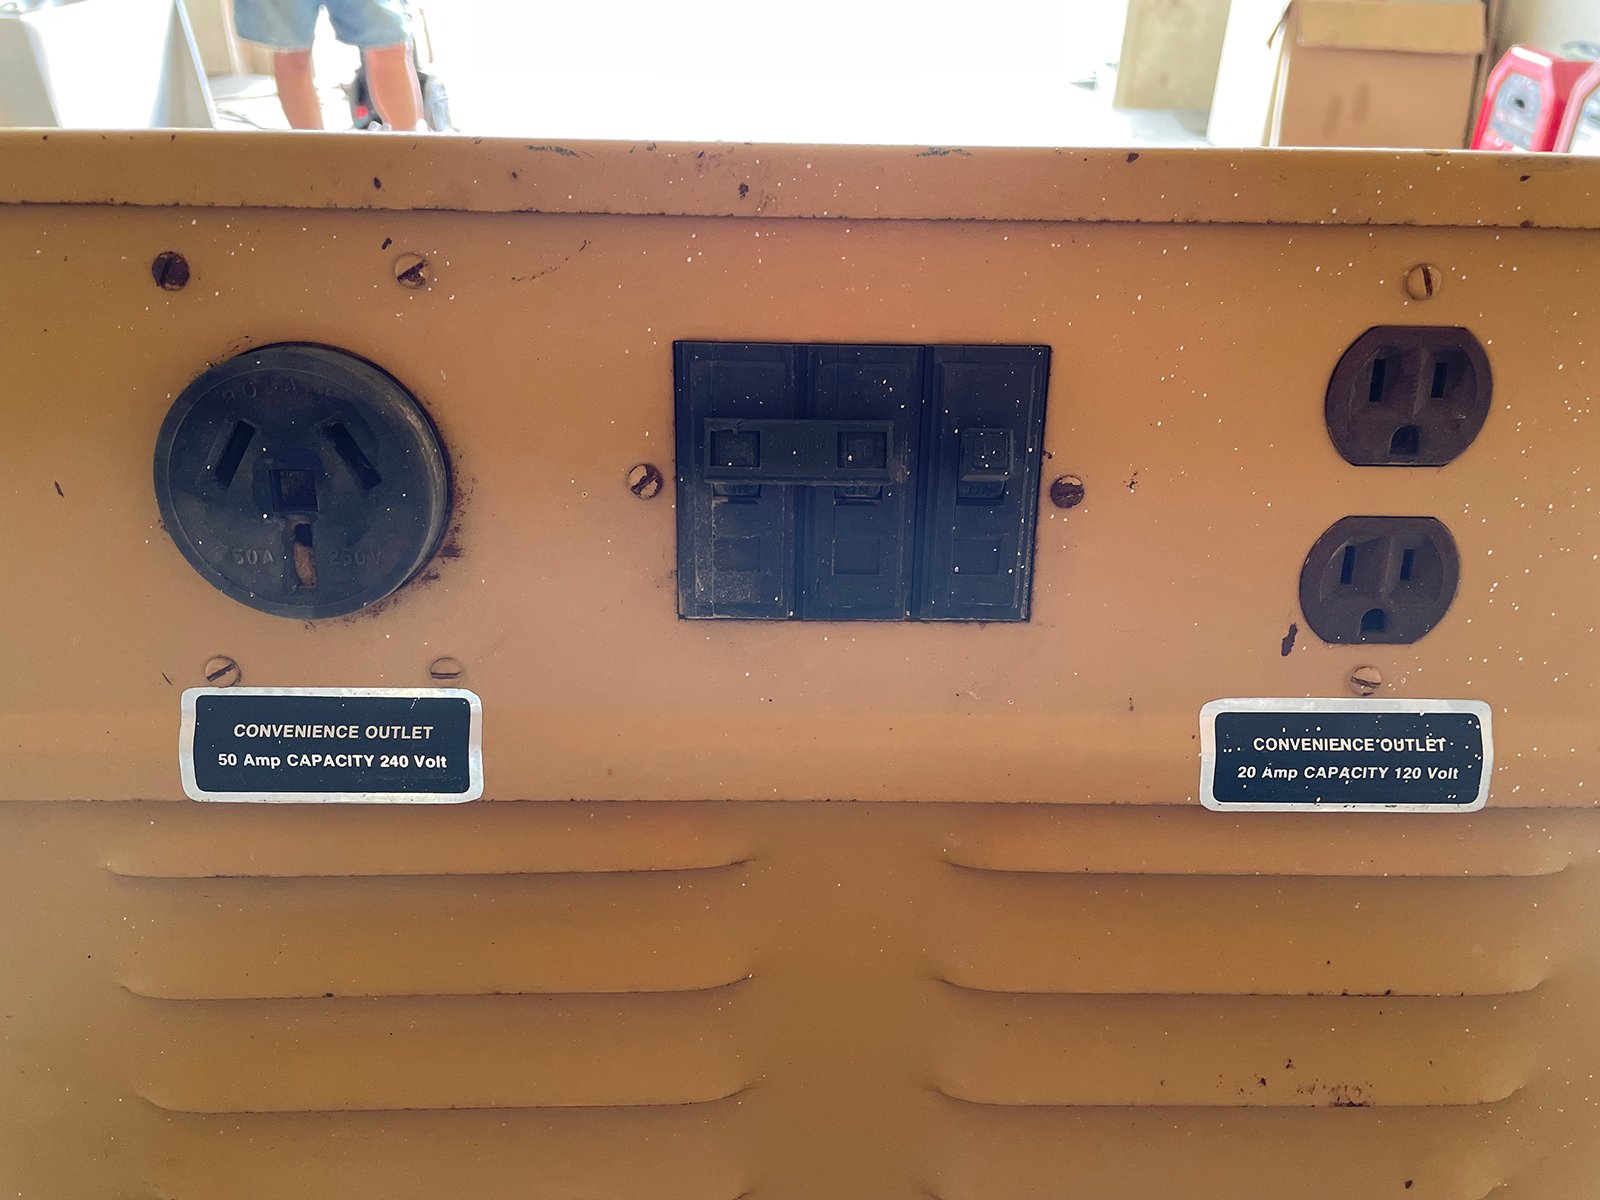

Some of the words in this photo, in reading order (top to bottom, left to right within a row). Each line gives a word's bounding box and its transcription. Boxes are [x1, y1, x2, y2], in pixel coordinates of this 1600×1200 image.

[232, 548, 275, 566] 50A
[233, 723, 360, 739] CONVENIENCE
[365, 725, 434, 740] OUTLET
[1253, 737, 1375, 752] CONVENIENCE
[1380, 737, 1447, 752] OUTLET
[218, 753, 238, 767] 50
[243, 753, 281, 770] Amp
[286, 753, 375, 768] CAPACITY
[379, 754, 409, 768] 240
[413, 754, 448, 769] Volt
[1237, 766, 1257, 779] 20
[1261, 766, 1298, 782] Amp
[1303, 766, 1389, 780] CAPACITY
[1394, 766, 1422, 780] 120
[1427, 766, 1459, 780] Volt
